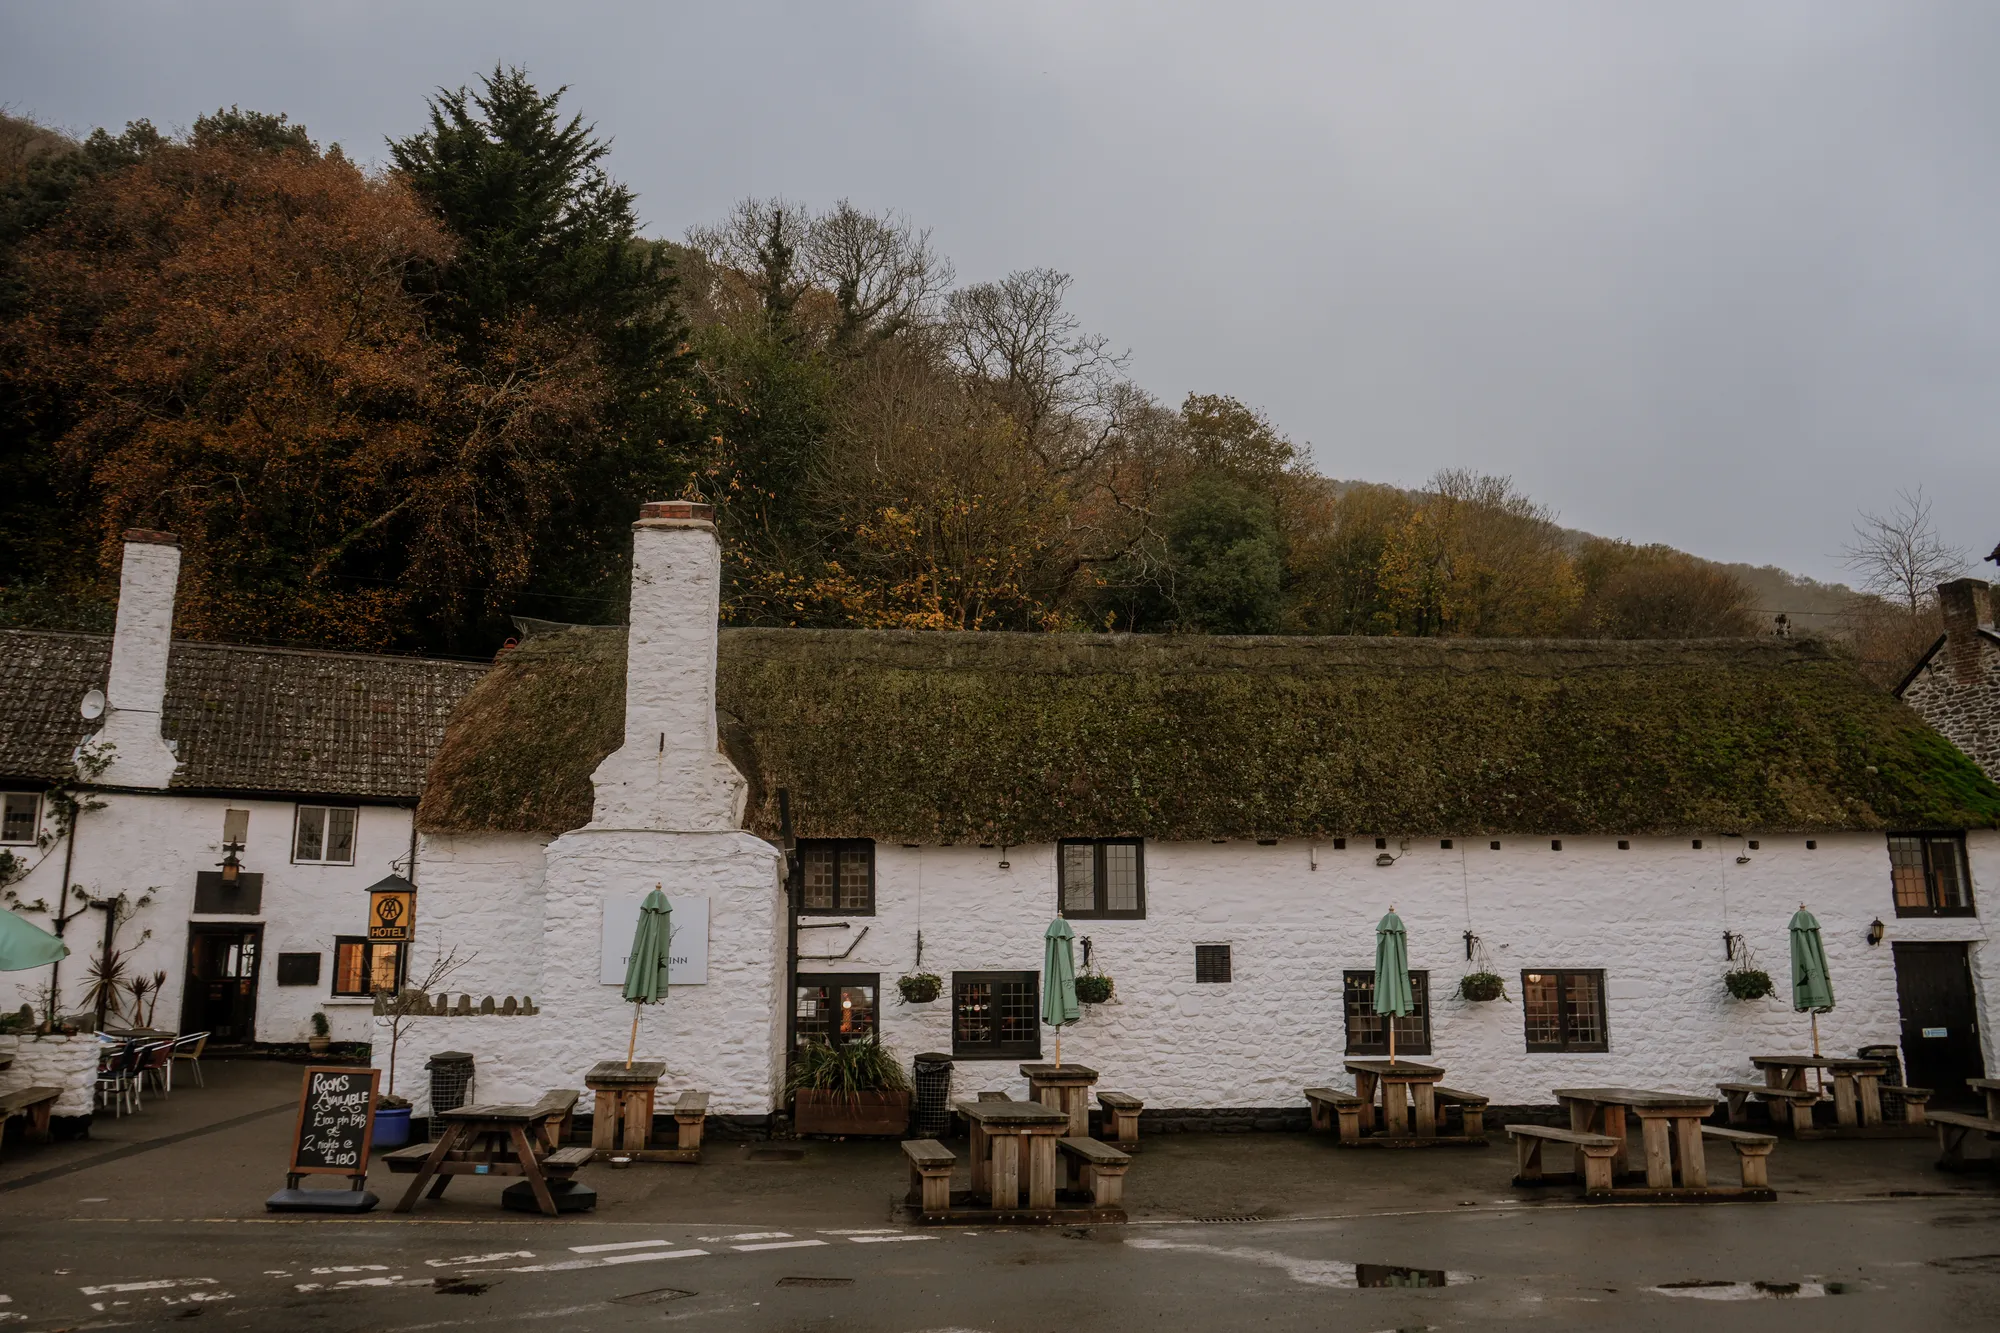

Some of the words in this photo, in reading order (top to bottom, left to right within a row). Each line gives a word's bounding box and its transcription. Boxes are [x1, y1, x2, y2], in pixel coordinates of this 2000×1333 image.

[381, 899, 398, 918] AA
[371, 928, 404, 937] HOTEL
[669, 957, 688, 965] INN
[314, 1091, 369, 1108] AVAILABLE
[313, 1112, 334, 1127] £100
[302, 1134, 316, 1151] 2
[317, 1138, 339, 1154] nights
[343, 1140, 353, 1148] @
[324, 1150, 357, 1165] £180
